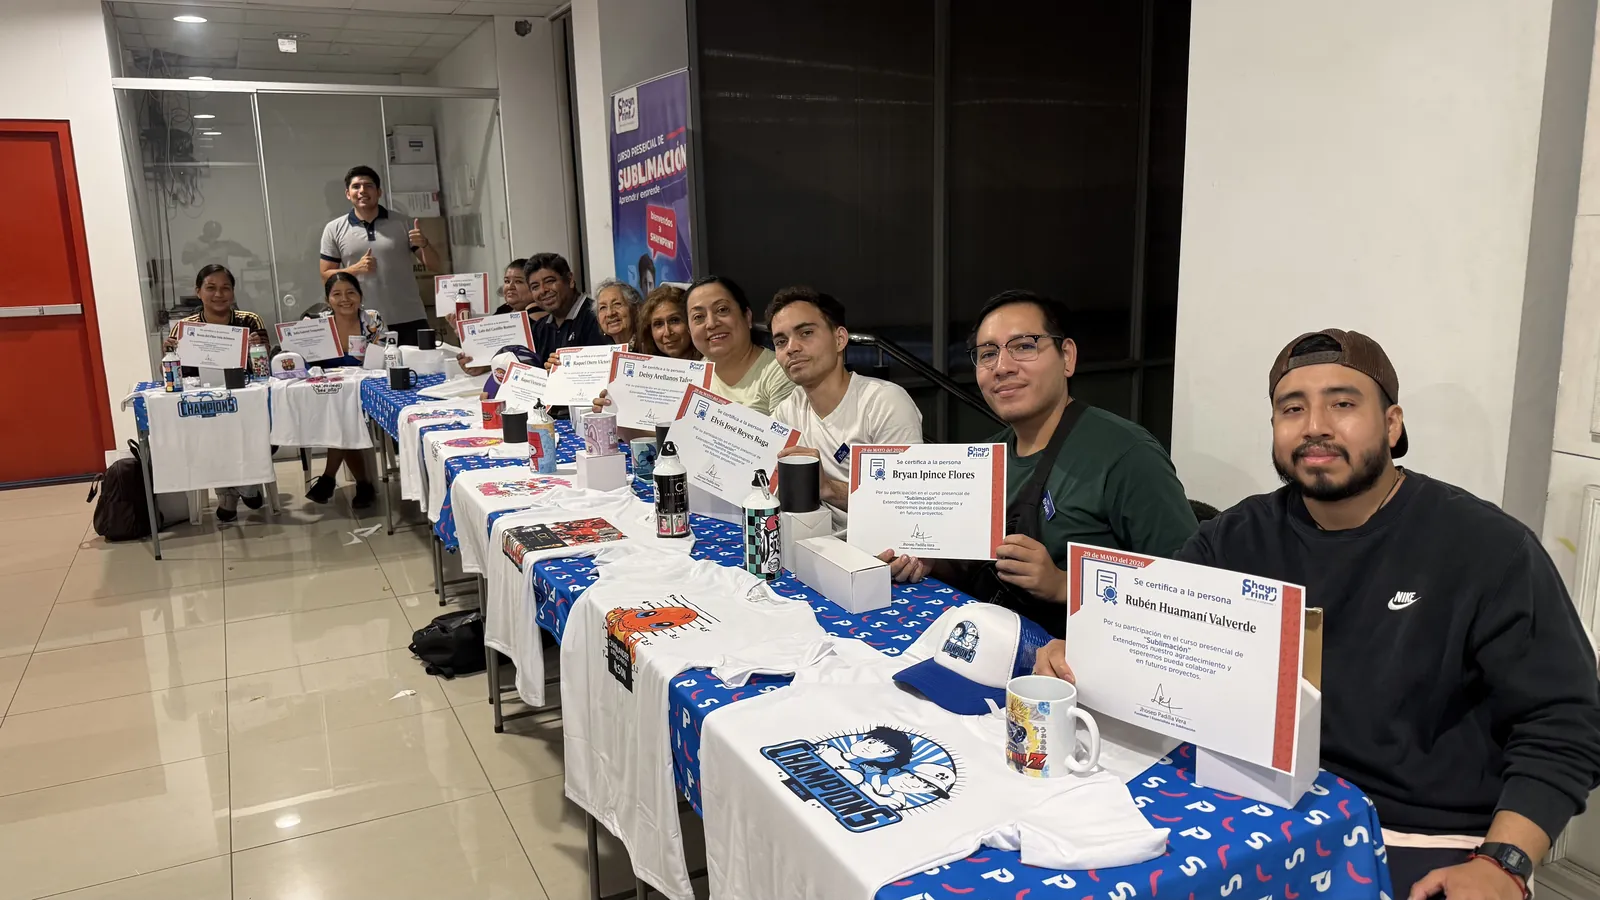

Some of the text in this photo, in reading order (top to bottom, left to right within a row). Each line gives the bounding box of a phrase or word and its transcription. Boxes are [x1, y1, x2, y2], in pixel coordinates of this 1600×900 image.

[657, 134, 665, 146] DE
[618, 141, 687, 191] SUBLIMACIÓN
[638, 371, 653, 380] Deisy
[653, 373, 678, 382] Arellanos
[180, 399, 236, 417] CHAMPIONS
[710, 415, 769, 447] Elvis José Reyes Raga
[967, 446, 990, 454] Shayn
[967, 450, 985, 458] Print
[892, 470, 975, 481] Bryan Ipince Flores
[1092, 551, 1099, 559] de
[1100, 552, 1118, 562] MAYO
[1129, 559, 1145, 568] 2026
[1134, 577, 1144, 586] Se
[1145, 580, 1178, 594] certifica
[1187, 588, 1195, 597] la
[1197, 592, 1232, 605] persona
[1242, 579, 1277, 594] Shayn
[1242, 586, 1269, 601] Print
[925, 598, 944, 606] P
[1394, 591, 1416, 603] NIKE
[880, 609, 899, 617] P
[1125, 594, 1257, 634] Rubén Huamaní Valverde
[832, 619, 852, 627] P
[891, 634, 912, 642] P
[1103, 618, 1114, 626] Por
[1123, 624, 1161, 639] participación
[1180, 638, 1197, 647] curso
[1199, 643, 1233, 656] presencial
[1112, 635, 1149, 650] Extendemos
[1150, 646, 1174, 657] nuestro
[1175, 652, 1226, 670] agradecimiento
[1129, 648, 1216, 675] esperemos pueda colaborar
[1145, 660, 1167, 671] futuros
[1168, 667, 1202, 680] proyectos.
[675, 679, 697, 688] P
[697, 698, 719, 708] S
[1026, 752, 1048, 771] Z
[764, 742, 898, 828] CHAMPIONS
[1142, 776, 1167, 788] S
[1184, 800, 1216, 813] P
[1241, 803, 1274, 817] P
[1303, 809, 1331, 825] S
[1178, 826, 1212, 840] P
[1244, 831, 1272, 850] S
[1343, 825, 1370, 847] S
[1179, 856, 1207, 877] S
[1284, 847, 1306, 870] S
[981, 868, 1015, 883] P
[1042, 873, 1077, 889] P
[1310, 869, 1331, 892] P
[1220, 873, 1243, 897] S
